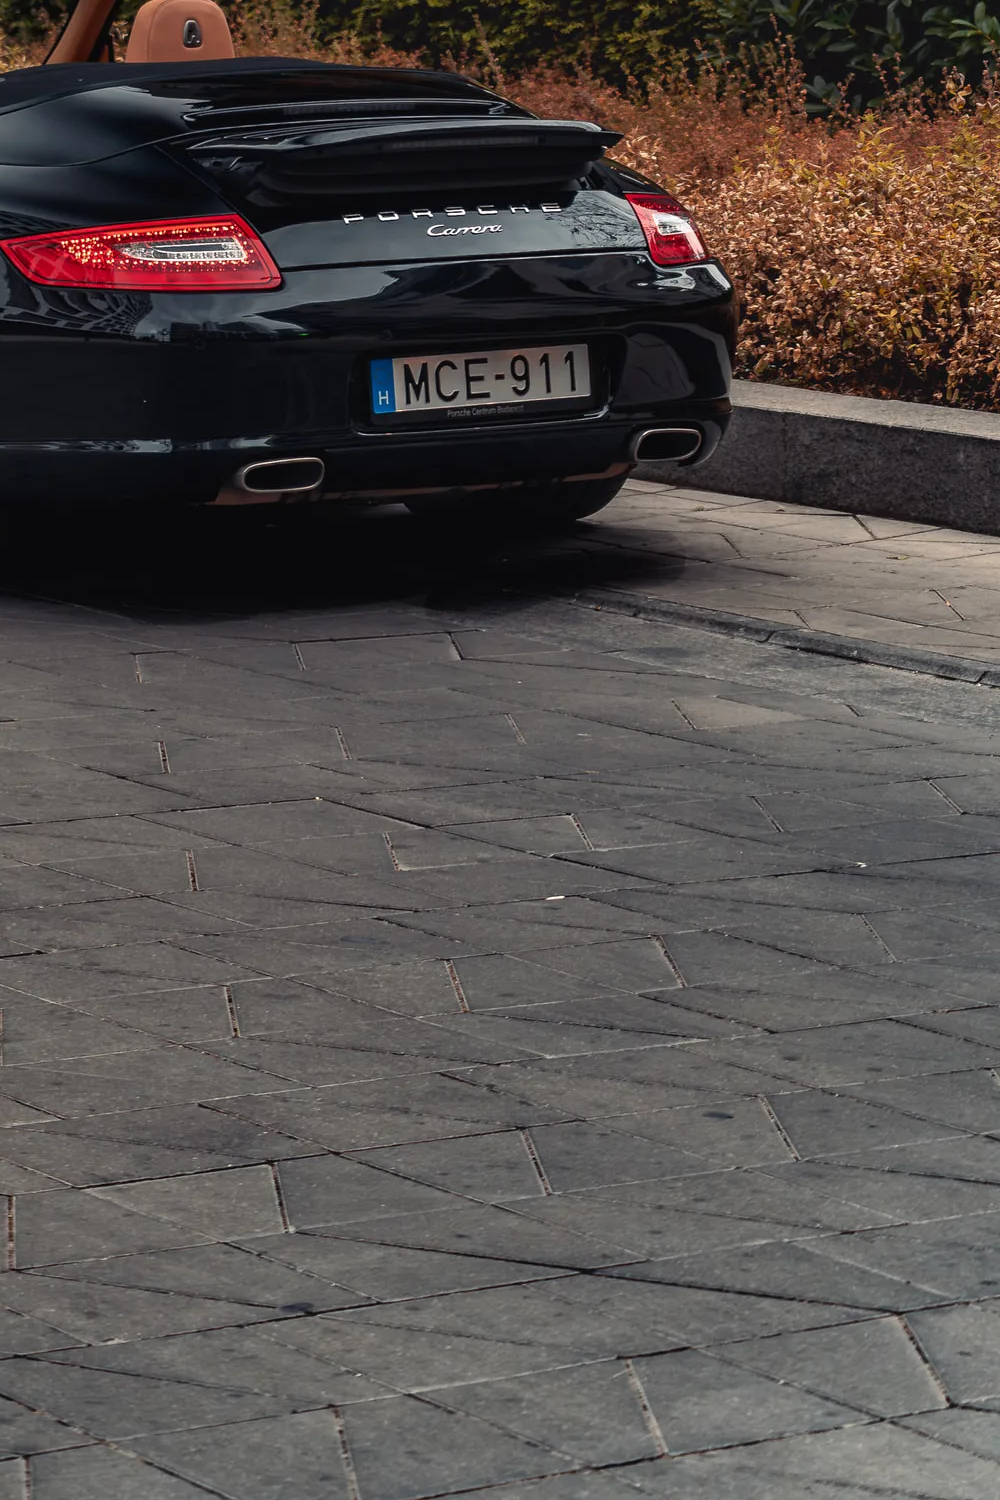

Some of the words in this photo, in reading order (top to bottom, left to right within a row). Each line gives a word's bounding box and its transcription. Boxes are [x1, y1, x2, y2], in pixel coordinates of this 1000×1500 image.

[342, 202, 562, 225] PORSCHE
[427, 223, 503, 237] Carrera
[378, 389, 389, 406] H
[403, 350, 576, 405] MCE-911
[447, 409, 471, 418] Porsche
[471, 406, 497, 416] Centrum
